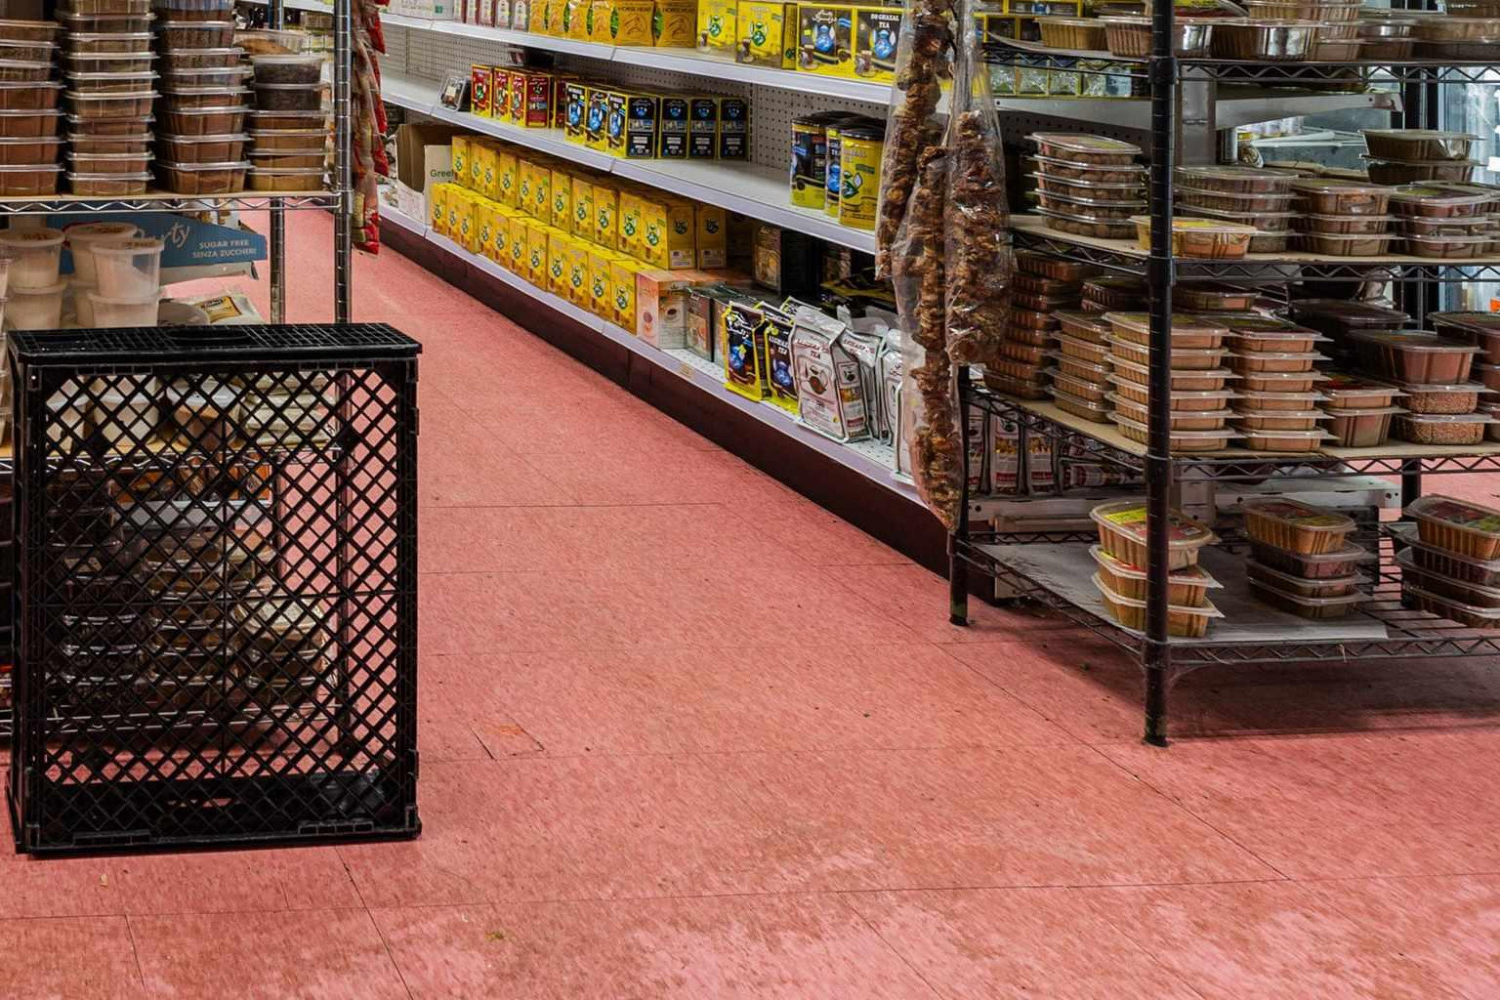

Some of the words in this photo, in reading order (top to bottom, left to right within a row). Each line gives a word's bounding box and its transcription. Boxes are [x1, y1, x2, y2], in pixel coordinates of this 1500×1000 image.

[199, 240, 228, 250] SUGAR
[229, 239, 250, 248] FREE
[192, 249, 219, 258] SENZA
